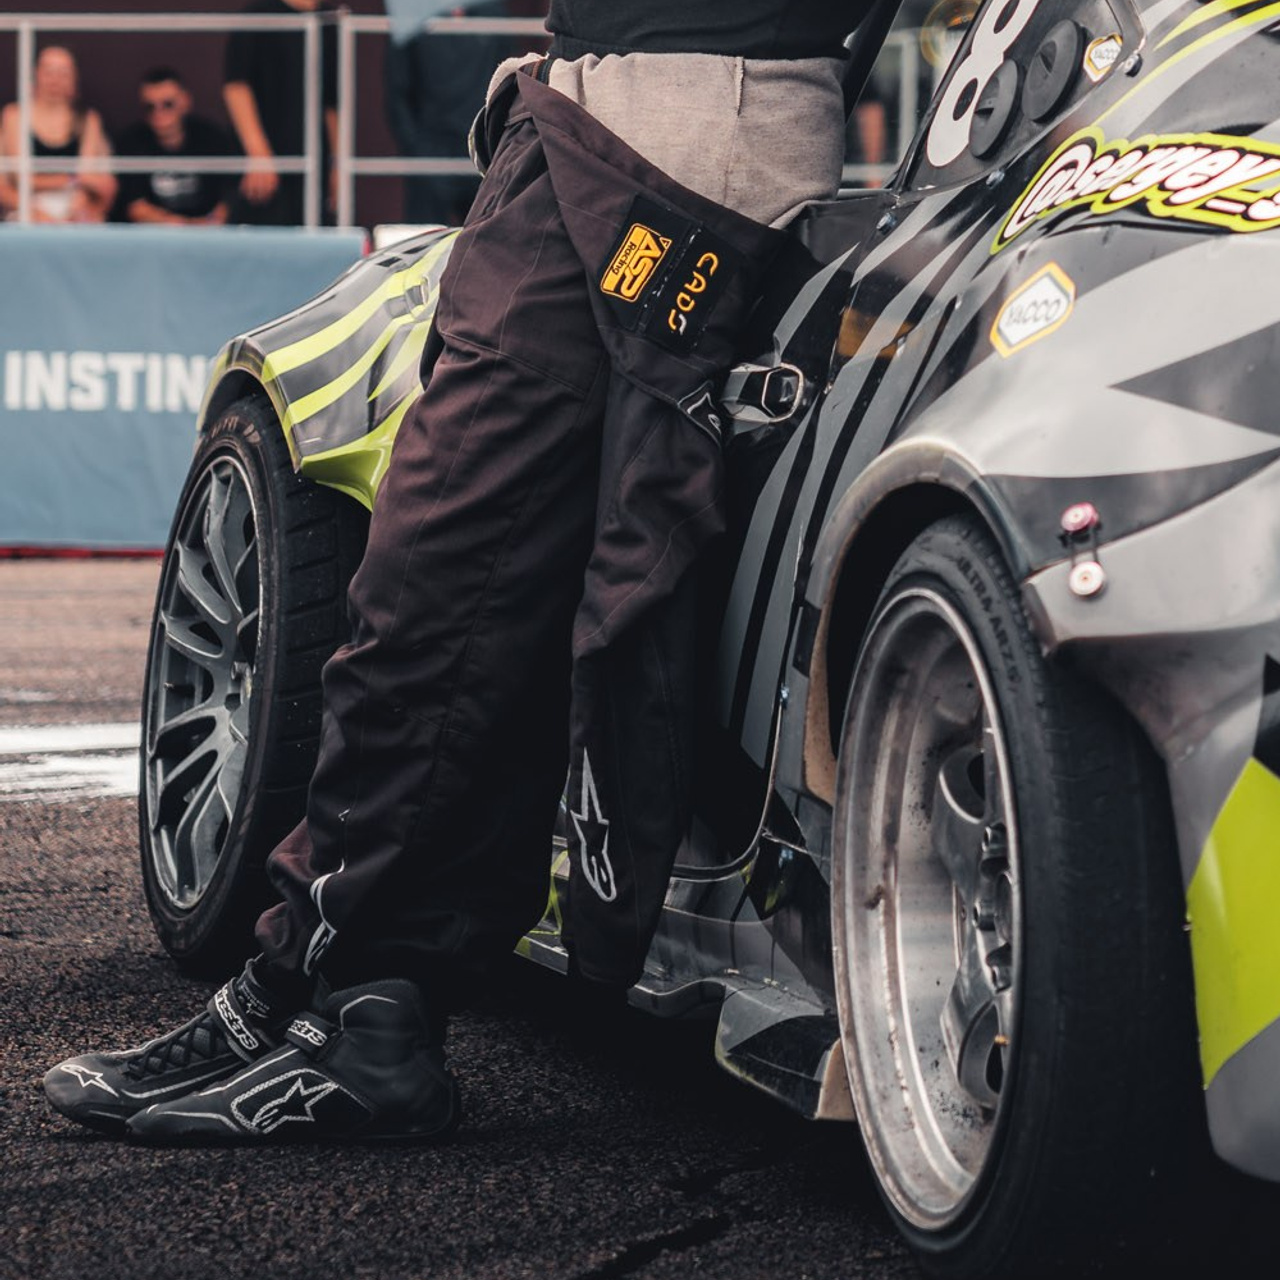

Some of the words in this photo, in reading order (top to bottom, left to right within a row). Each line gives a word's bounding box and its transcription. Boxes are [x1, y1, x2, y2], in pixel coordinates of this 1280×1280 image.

[611, 241, 638, 277] Racing
[619, 230, 663, 299] ASP
[4, 350, 214, 413] INSTIN
